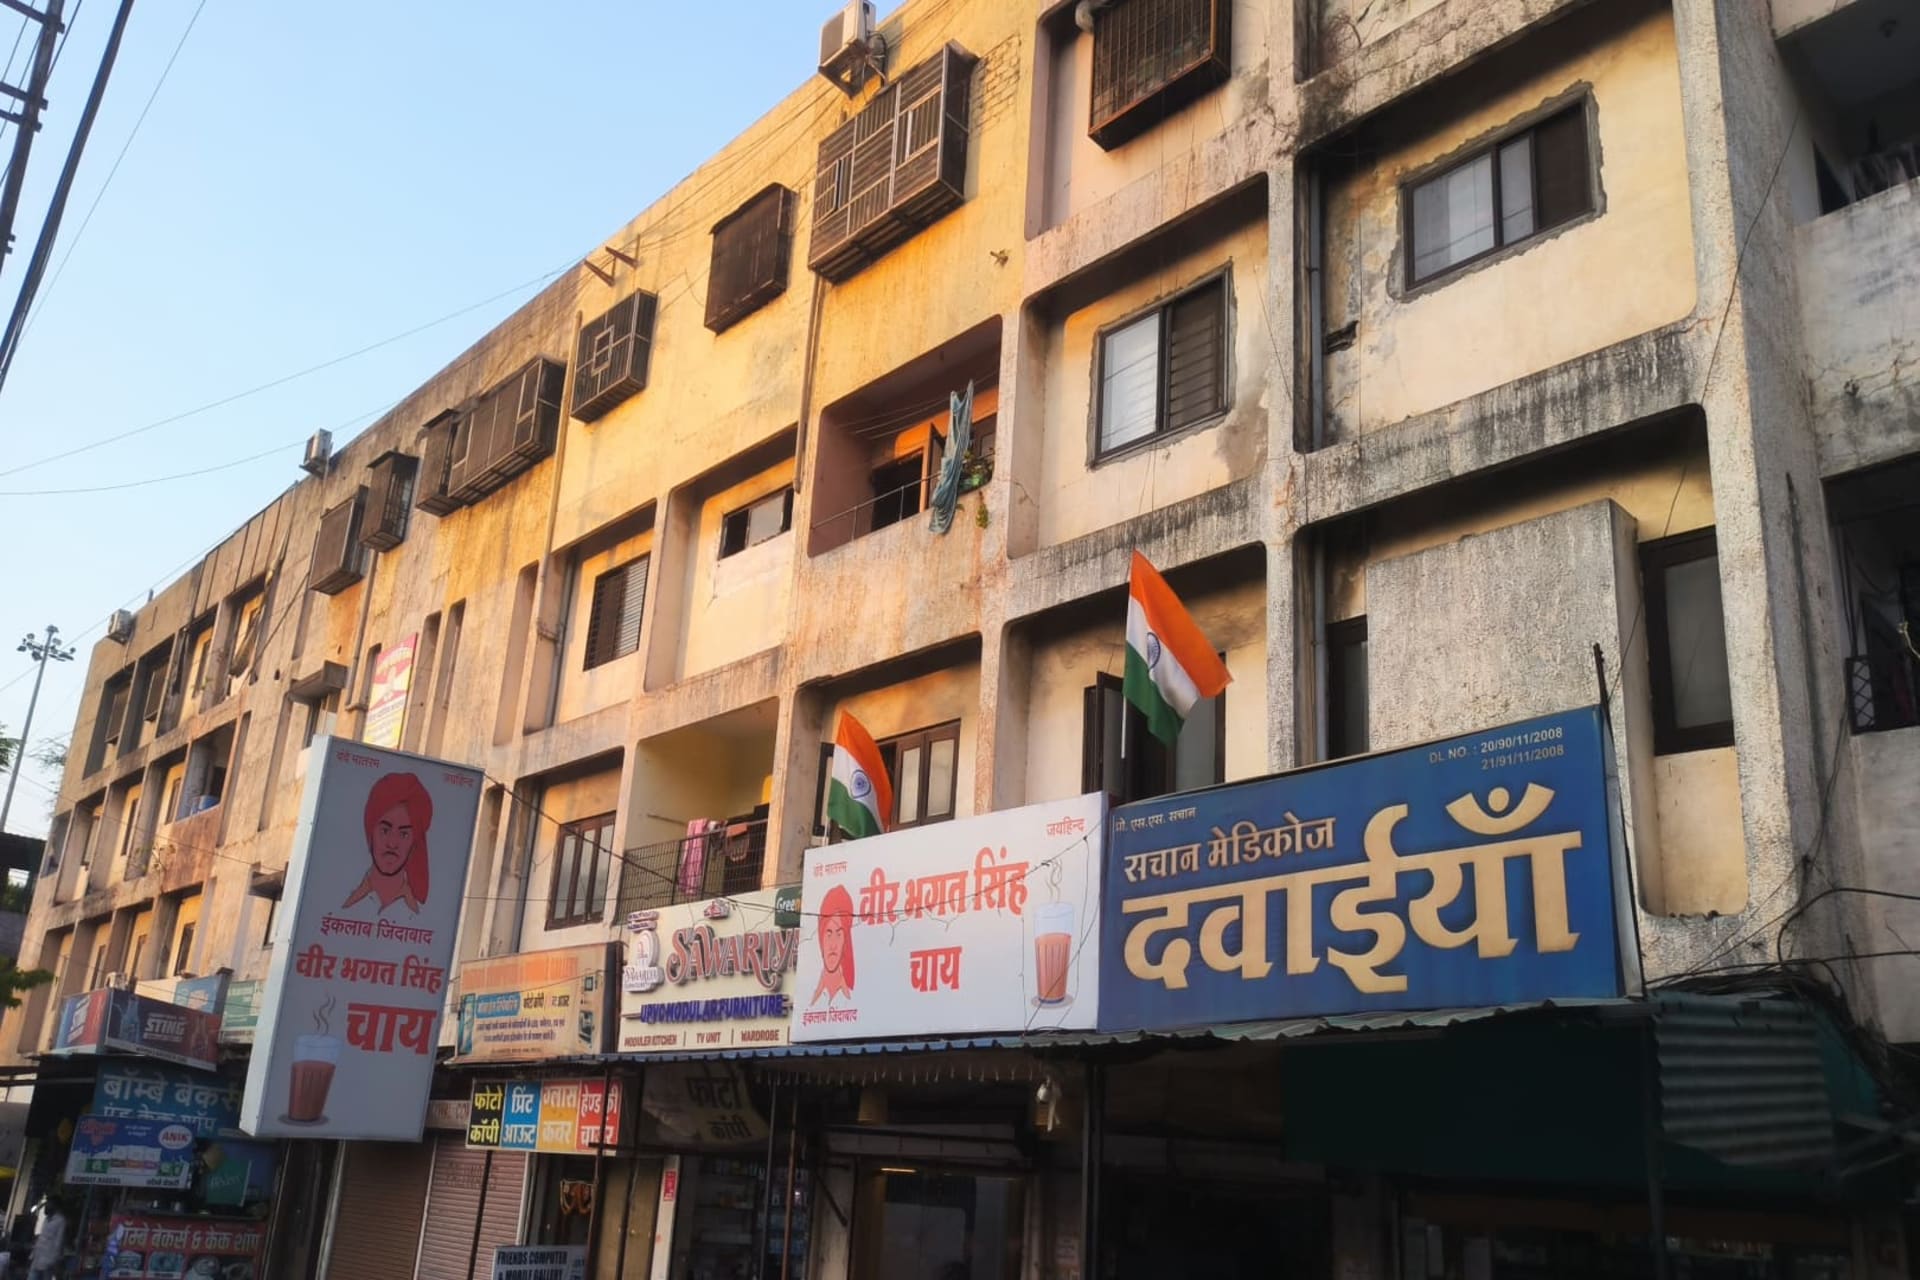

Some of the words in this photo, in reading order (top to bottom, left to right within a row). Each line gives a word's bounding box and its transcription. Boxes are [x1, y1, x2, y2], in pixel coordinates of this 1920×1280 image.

[1480, 727, 1563, 753] 20/90/11/2008
[1481, 744, 1564, 770] 21/91/11/2008
[1168, 807, 1196, 822] सचान
[1124, 842, 1201, 884] सचान
[1207, 811, 1336, 869] मेडिकोज
[859, 867, 899, 925] वीर
[904, 870, 968, 920] भगत
[974, 846, 1029, 916] सिंह
[1122, 782, 1582, 994] दवाईयाँ
[321, 911, 372, 938] इंकलाब
[376, 915, 434, 946] जिंदाबाद
[296, 943, 337, 979] वीर
[340, 956, 397, 985] भगत
[402, 953, 444, 994] सिंह
[910, 946, 962, 992] चाय
[144, 1018, 187, 1037] STING
[346, 1003, 437, 1056] चाय
[697, 1032, 705, 1043] TV
[706, 1032, 721, 1043] UNIT
[741, 1029, 780, 1042] WARDROBE
[103, 1067, 168, 1104] बॉम्बे
[474, 1086, 502, 1112] फोटो
[512, 1086, 534, 1114] प्रिंट
[162, 1132, 188, 1142] ANIK
[470, 1117, 500, 1145] कॉपी
[497, 1251, 528, 1265] FRIENDS
[529, 1250, 568, 1264] COMPUTER
